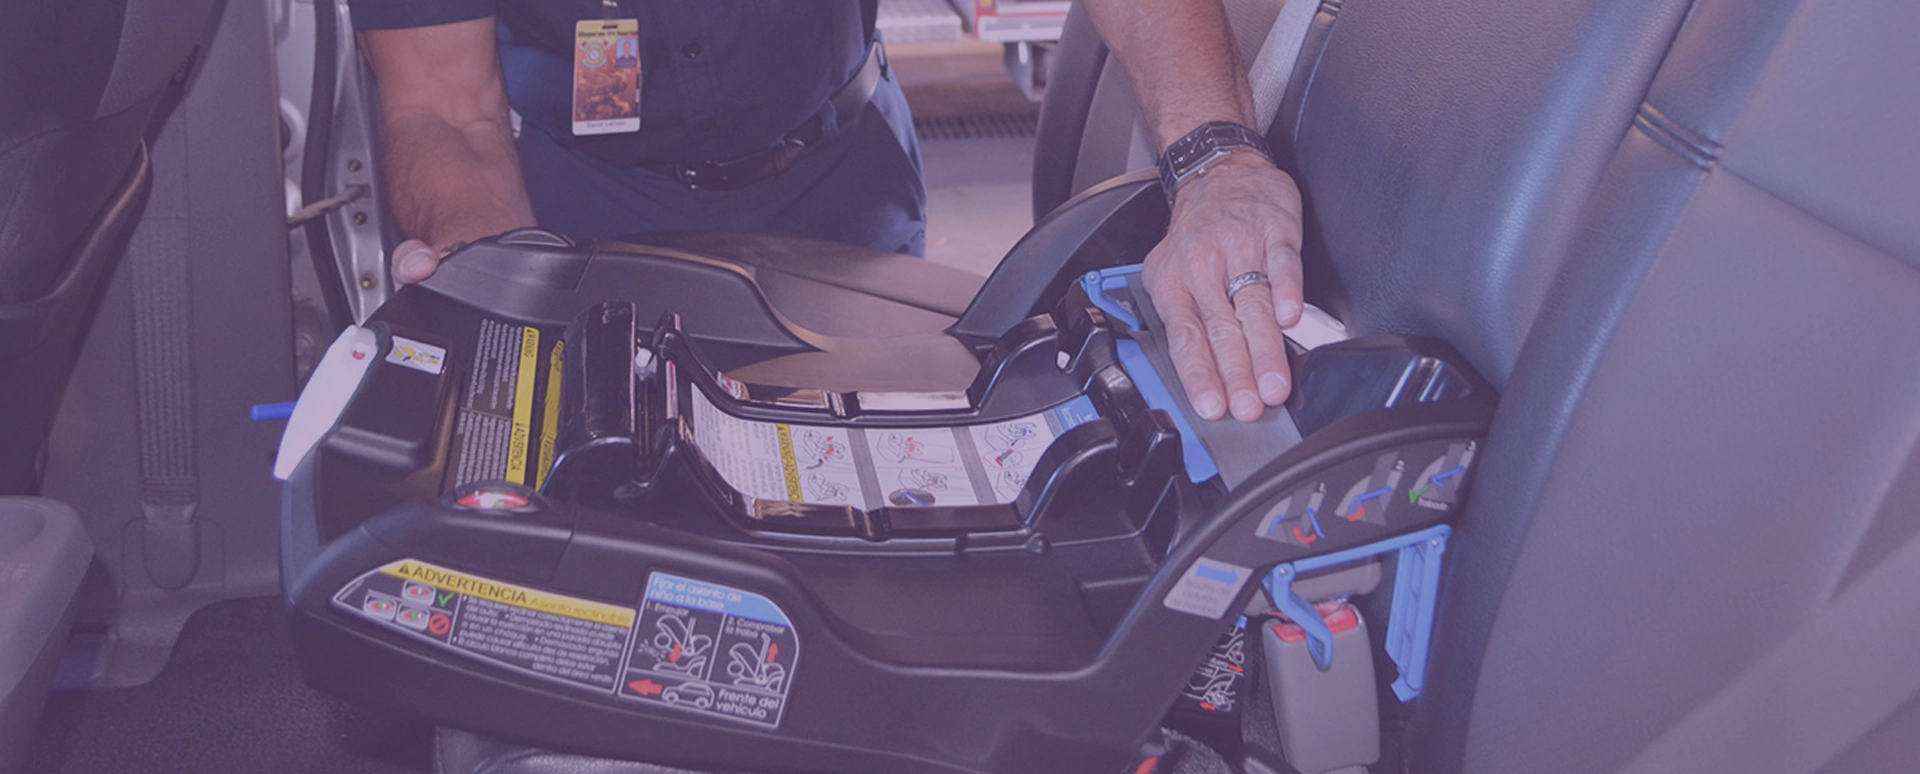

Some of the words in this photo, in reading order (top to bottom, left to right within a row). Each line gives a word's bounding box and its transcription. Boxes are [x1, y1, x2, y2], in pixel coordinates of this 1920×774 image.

[412, 565, 527, 604] ADVERTENCIA
[653, 576, 674, 592] Fijar
[675, 582, 687, 592] el
[687, 584, 725, 599] asiento
[726, 592, 742, 603] de
[654, 603, 689, 618] Empujar
[675, 594, 684, 602] a
[685, 594, 696, 604] la
[697, 597, 724, 610] base
[725, 625, 734, 633] la
[735, 627, 758, 638] traba
[736, 618, 785, 635] Comprobar
[718, 688, 756, 704] Frente
[758, 696, 779, 709] del
